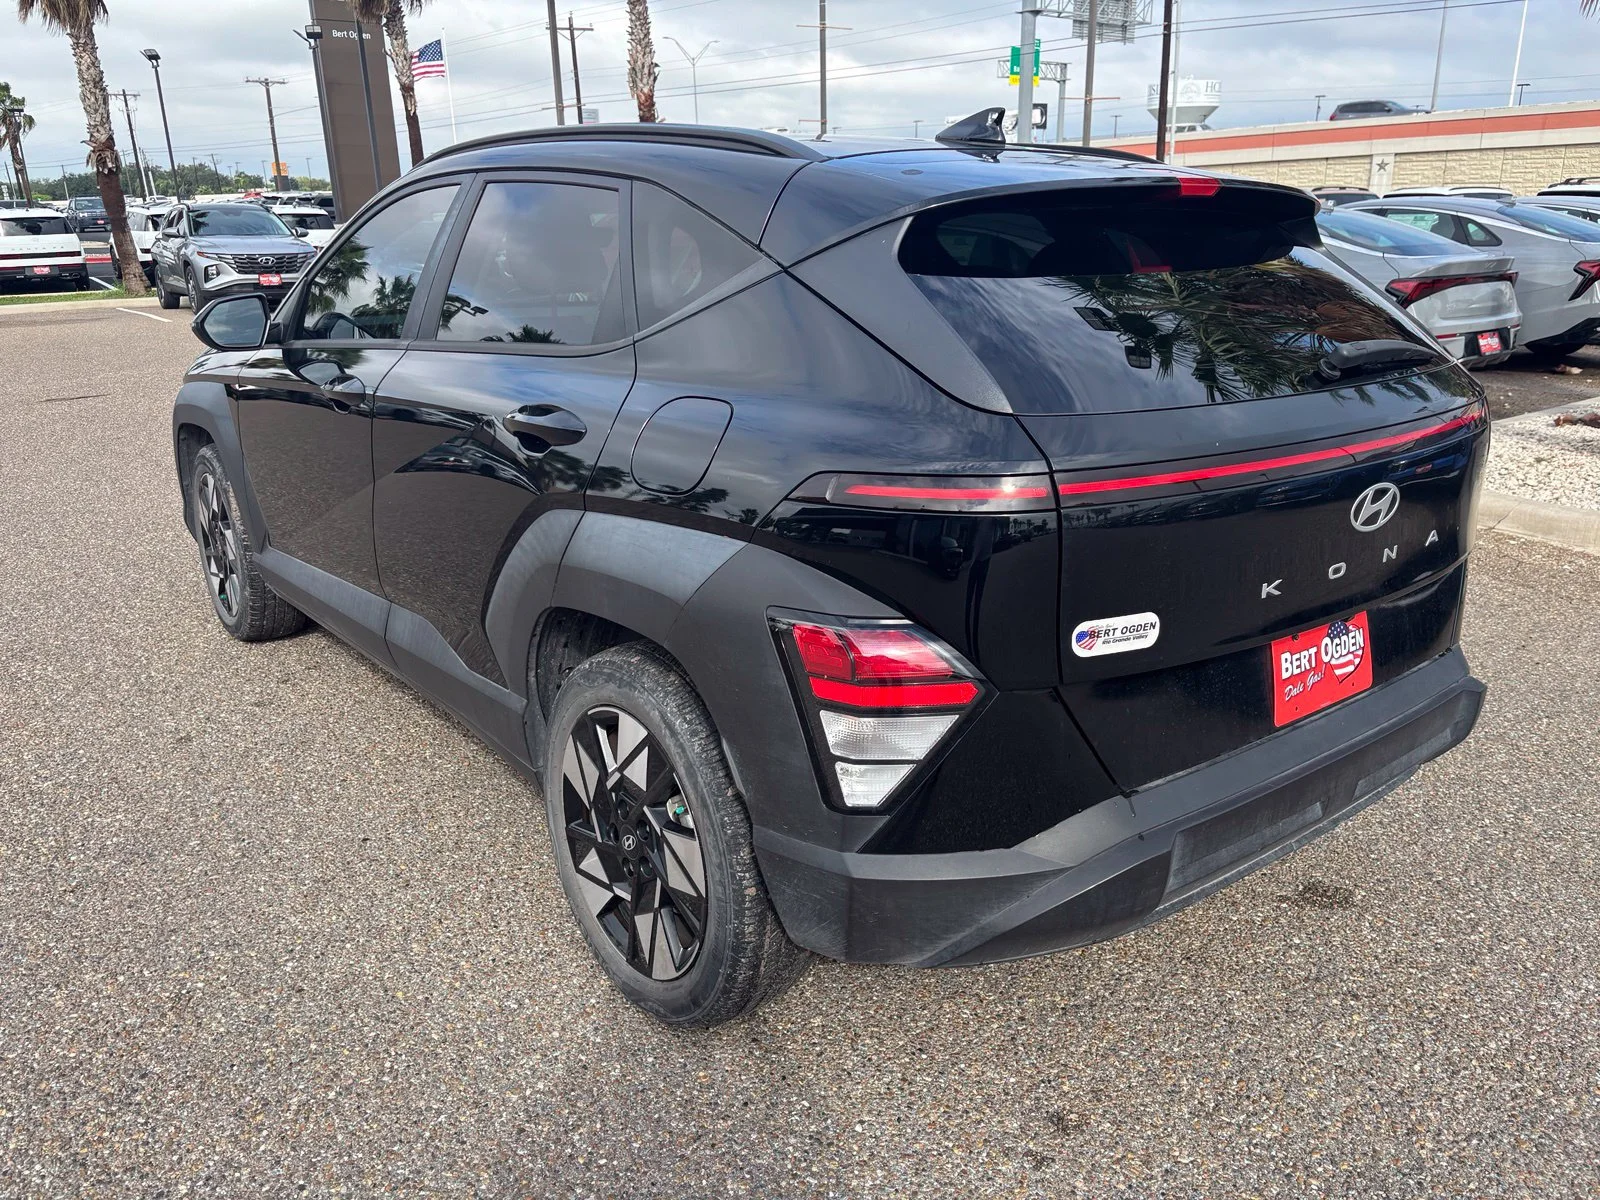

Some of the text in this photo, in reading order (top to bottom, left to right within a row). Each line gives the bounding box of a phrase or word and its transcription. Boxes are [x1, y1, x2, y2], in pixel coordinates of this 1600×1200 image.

[332, 29, 371, 40] Bert Ogen
[1261, 530, 1439, 599] KONA
[1089, 621, 1157, 639] BERT OGDEN
[1281, 627, 1365, 680] BERT OGDEN
[1284, 663, 1327, 701] Dale Gas!
